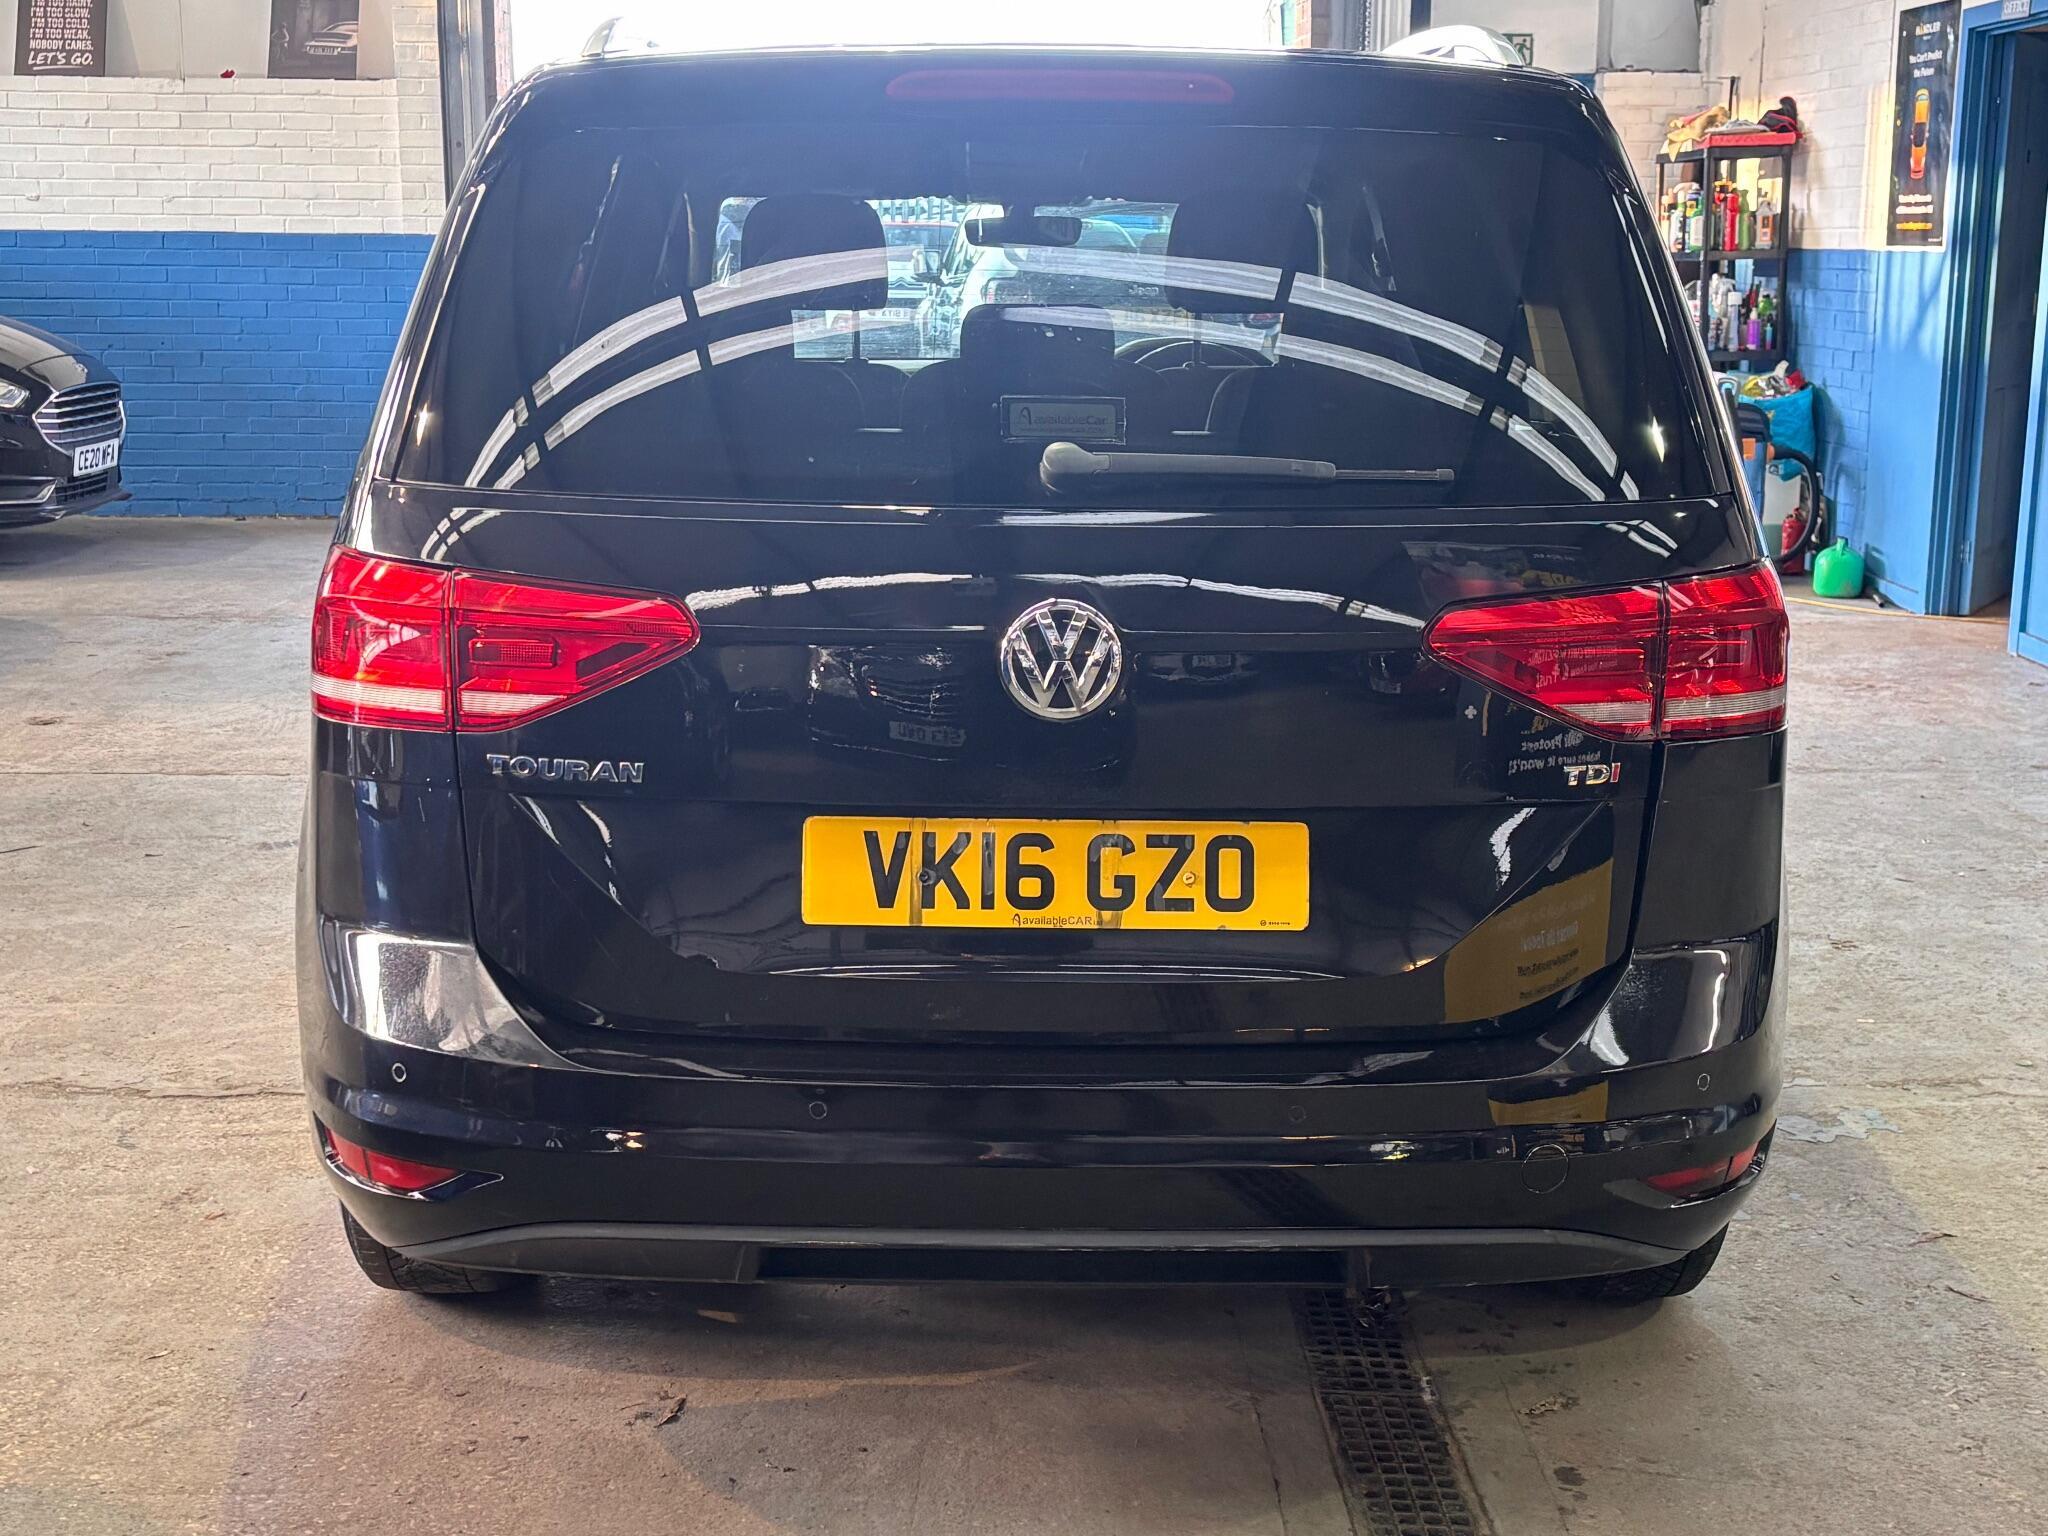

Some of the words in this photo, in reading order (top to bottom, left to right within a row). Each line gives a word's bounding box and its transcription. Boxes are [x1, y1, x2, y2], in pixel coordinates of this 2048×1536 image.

[46, 7, 63, 17] TOO
[65, 8, 91, 18] SLOW.
[47, 18, 64, 28] TOO
[65, 18, 90, 29] COLD.
[45, 29, 62, 39] TOO
[64, 29, 91, 39] WEAK.
[29, 39, 63, 49] NOBODY
[65, 40, 94, 50] CARES.
[28, 51, 67, 65] LET'S
[70, 52, 94, 65] GO.
[1128, 285, 1159, 297] Jeep
[79, 448, 101, 471] CE20
[486, 753, 645, 783] TOURAN
[1563, 762, 1621, 786] TDI
[863, 830, 1055, 912] VK16
[1086, 832, 1256, 912] GZO
